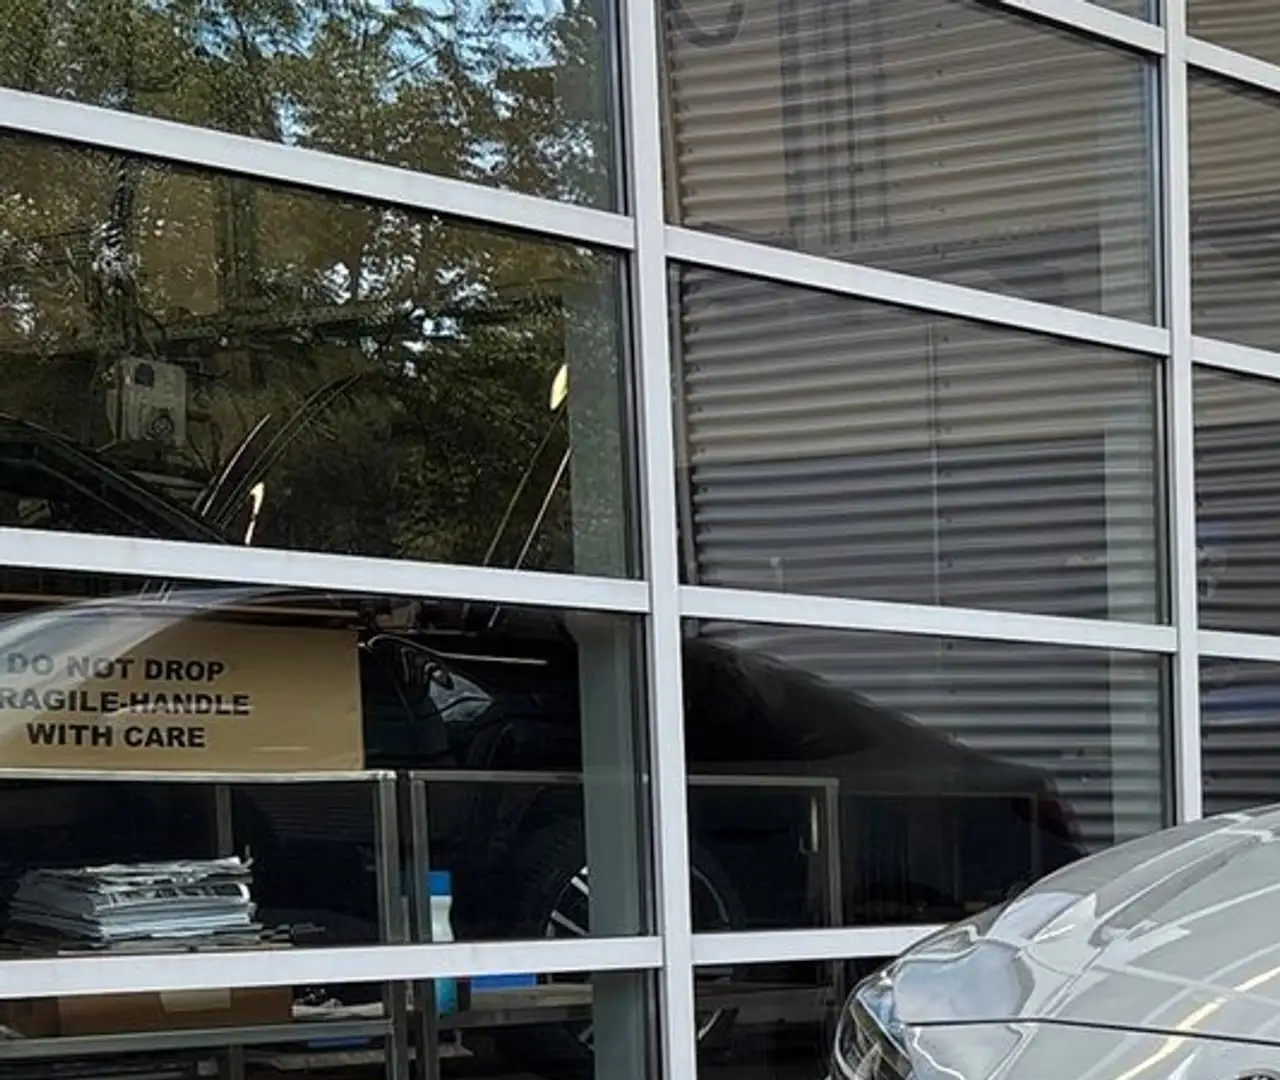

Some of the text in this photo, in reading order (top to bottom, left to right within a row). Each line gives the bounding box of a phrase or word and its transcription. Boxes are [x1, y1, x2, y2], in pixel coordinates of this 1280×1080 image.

[7, 653, 225, 681] DO NOT DROP
[0, 688, 251, 716] RAGILE-HANDLE
[27, 723, 206, 748] WITH CARE
